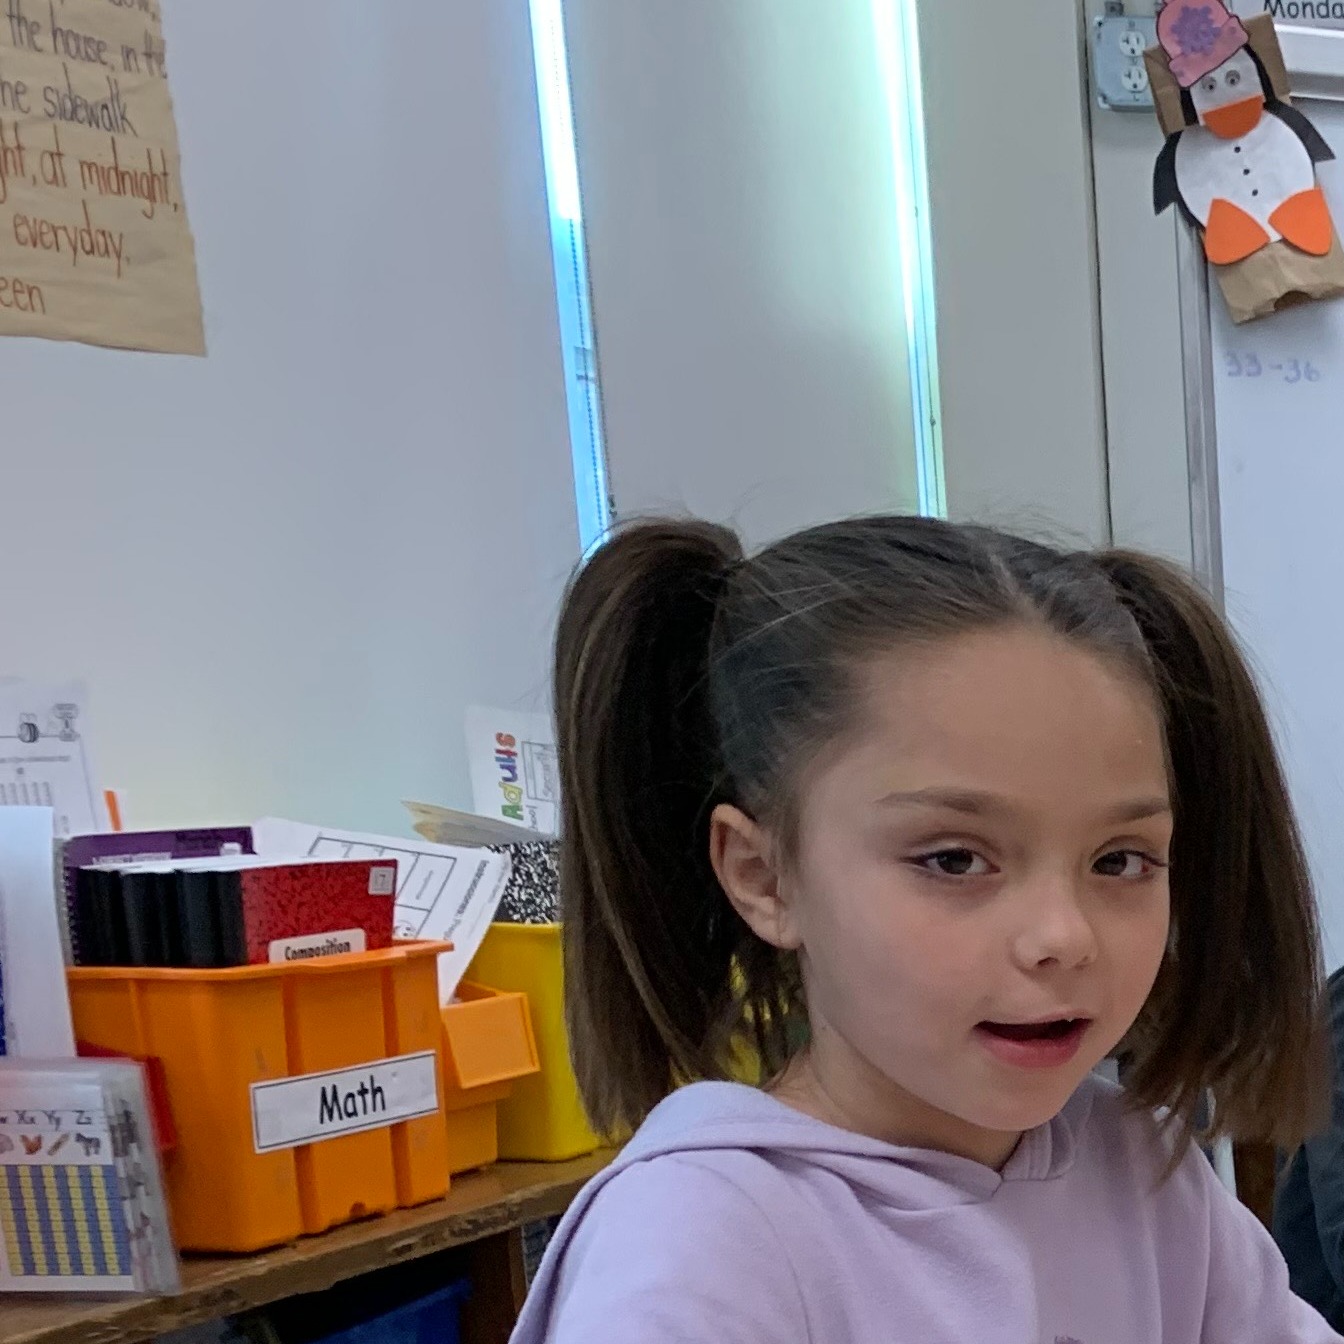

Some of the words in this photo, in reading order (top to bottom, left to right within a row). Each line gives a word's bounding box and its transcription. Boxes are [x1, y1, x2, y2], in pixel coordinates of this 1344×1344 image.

[43, 61, 139, 138] sidewalk
[79, 135, 178, 220] midnight,
[12, 199, 131, 279] everyday.
[494, 731, 525, 822] Adults
[319, 1074, 387, 1125] Math
